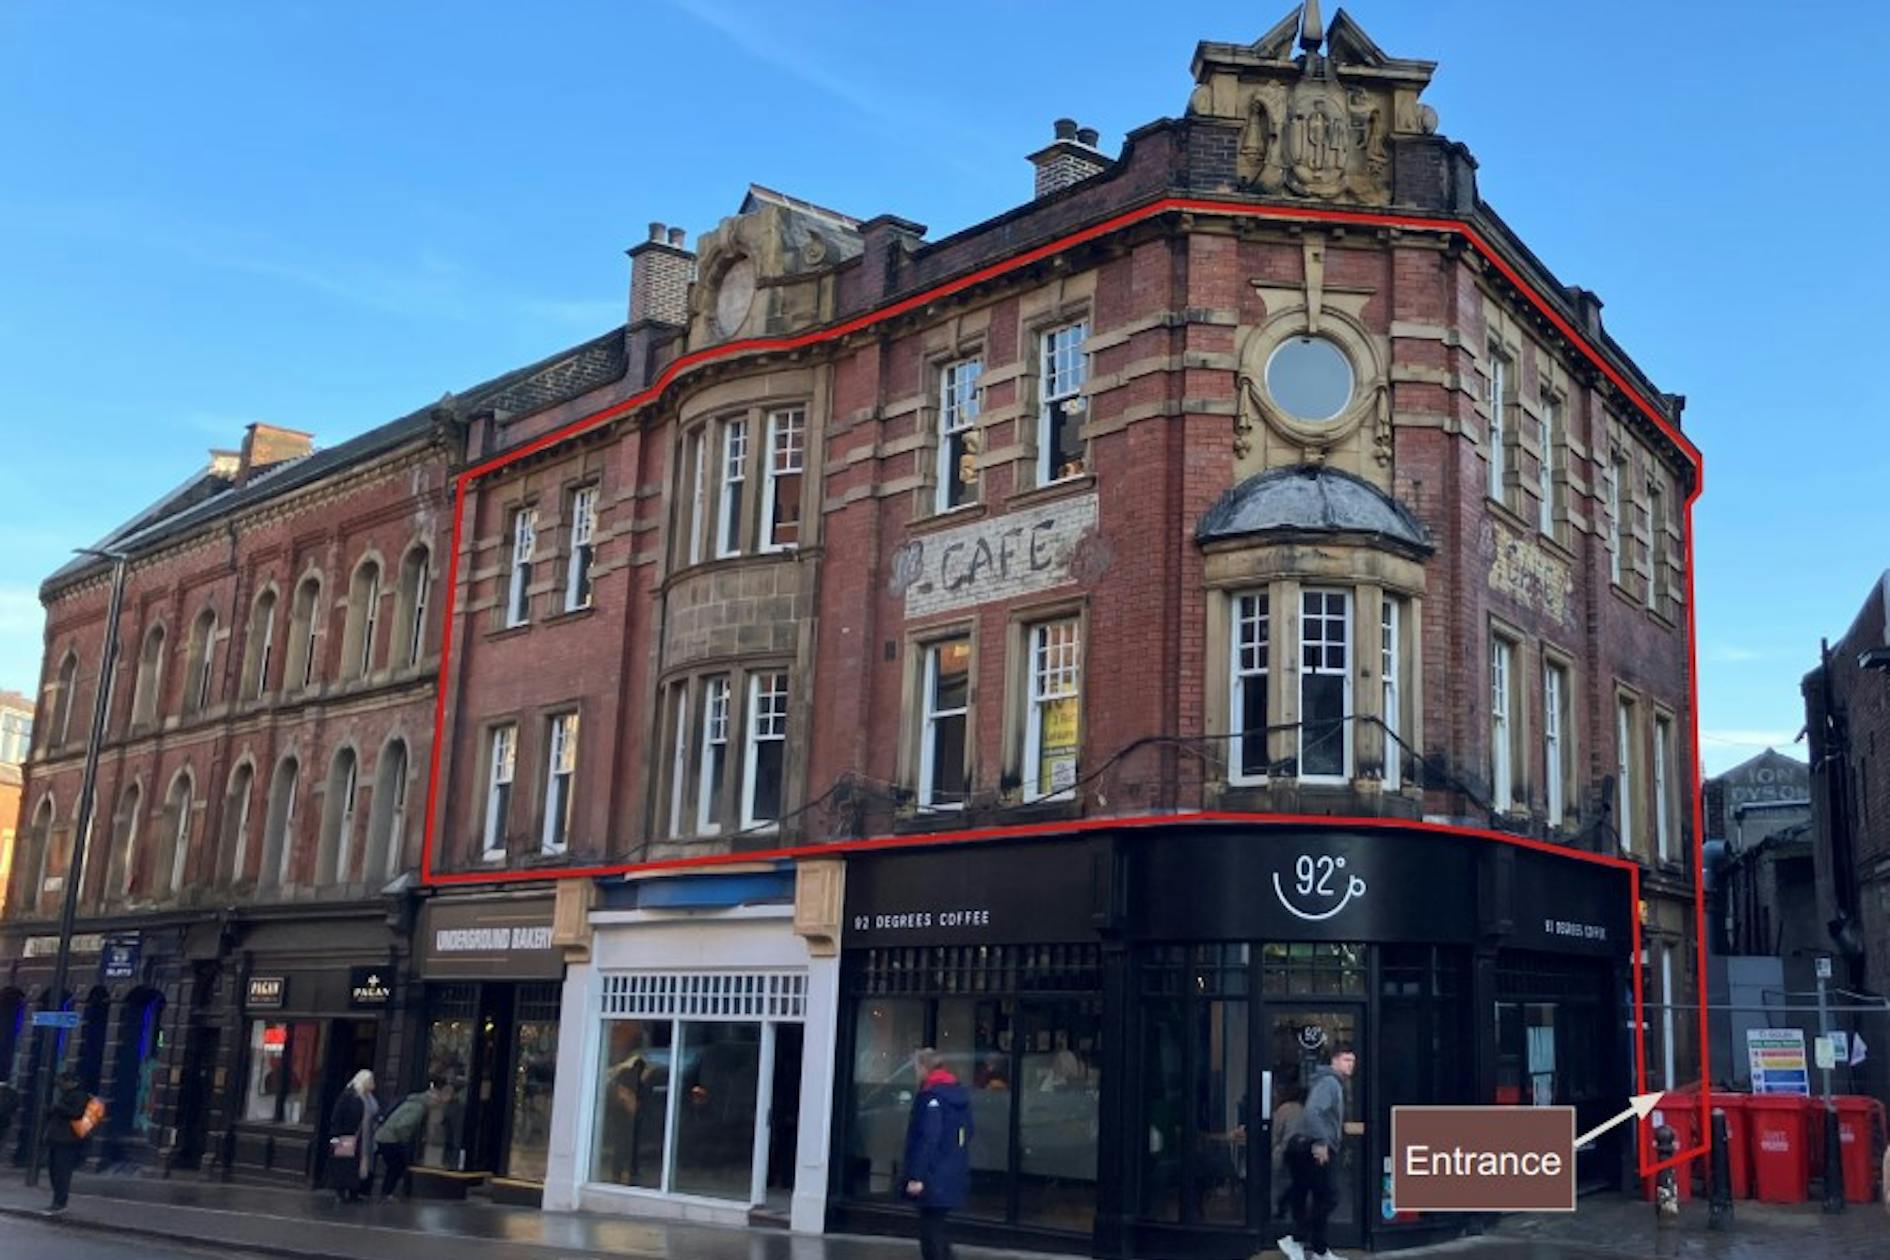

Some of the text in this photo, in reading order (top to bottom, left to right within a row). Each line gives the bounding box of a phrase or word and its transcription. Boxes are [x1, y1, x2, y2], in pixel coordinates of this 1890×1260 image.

[876, 913, 931, 928] DEGREES
[940, 911, 989, 926] COFFEE
[436, 927, 511, 951] UNDERGROUND
[353, 987, 391, 997] PAGAN
